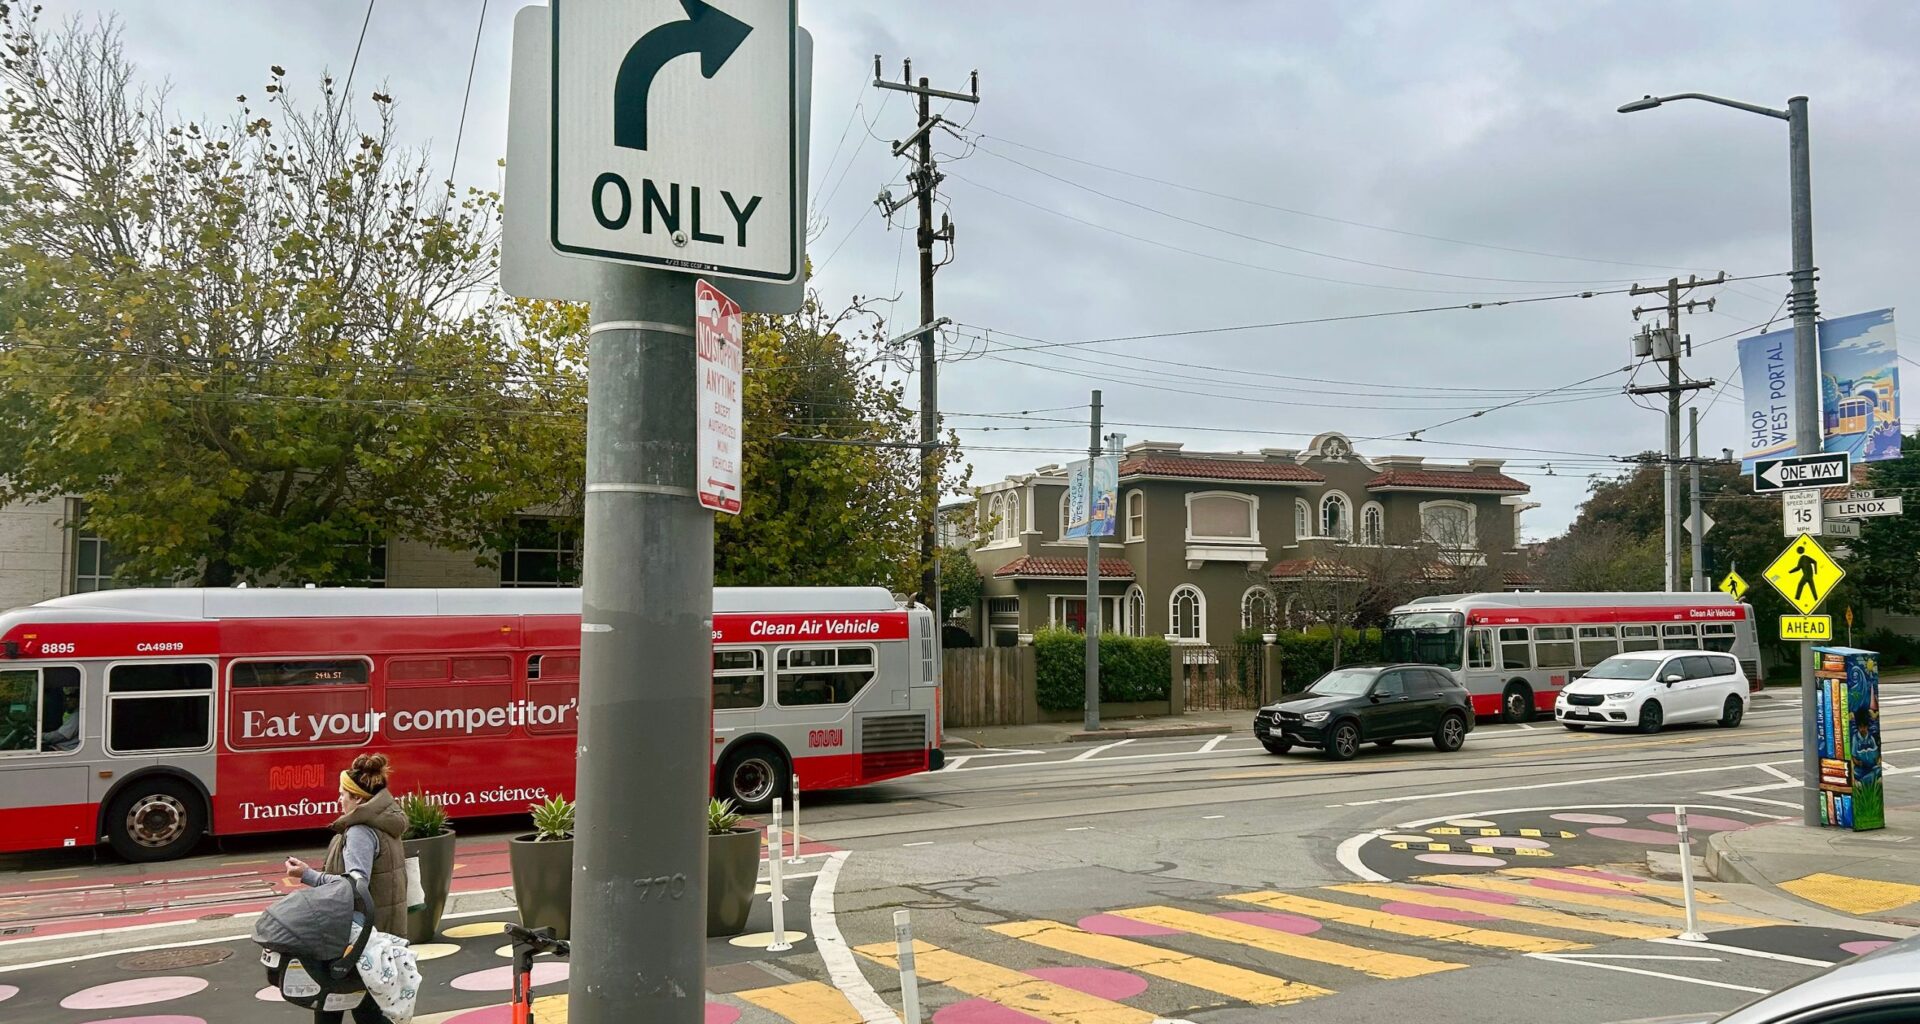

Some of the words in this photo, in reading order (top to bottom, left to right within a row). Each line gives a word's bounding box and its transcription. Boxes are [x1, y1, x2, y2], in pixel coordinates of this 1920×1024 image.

[591, 171, 763, 248] ONLY
[699, 321, 711, 359] NO
[1766, 342, 1787, 399] PORTAL
[706, 367, 736, 403] ANYTIME
[714, 402, 730, 417] EXCEPT
[1752, 410, 1768, 448] SHOP
[1771, 405, 1788, 446] WEST
[1780, 465, 1807, 480] ONE
[1811, 462, 1840, 478] WAY
[1850, 491, 1871, 499] END
[1794, 509, 1812, 522] 15
[1839, 501, 1885, 515] LENOX
[1830, 524, 1851, 534] ULLOA
[1689, 608, 1706, 617] Clean
[1706, 609, 1715, 617] Air
[1716, 608, 1736, 617] Vehicle
[750, 619, 796, 636] Clean
[798, 619, 823, 634] Air
[825, 618, 880, 634] Vehicle
[1786, 621, 1825, 634] AHEAD
[41, 642, 75, 654] 8895
[136, 641, 184, 652] CA49819
[333, 671, 342, 679] ST
[241, 709, 301, 739] Eat
[308, 708, 386, 741] your
[393, 697, 580, 733] competitor'
[425, 789, 460, 807] into
[464, 791, 477, 804] a
[479, 785, 550, 804] science.
[633, 872, 687, 903] 770
